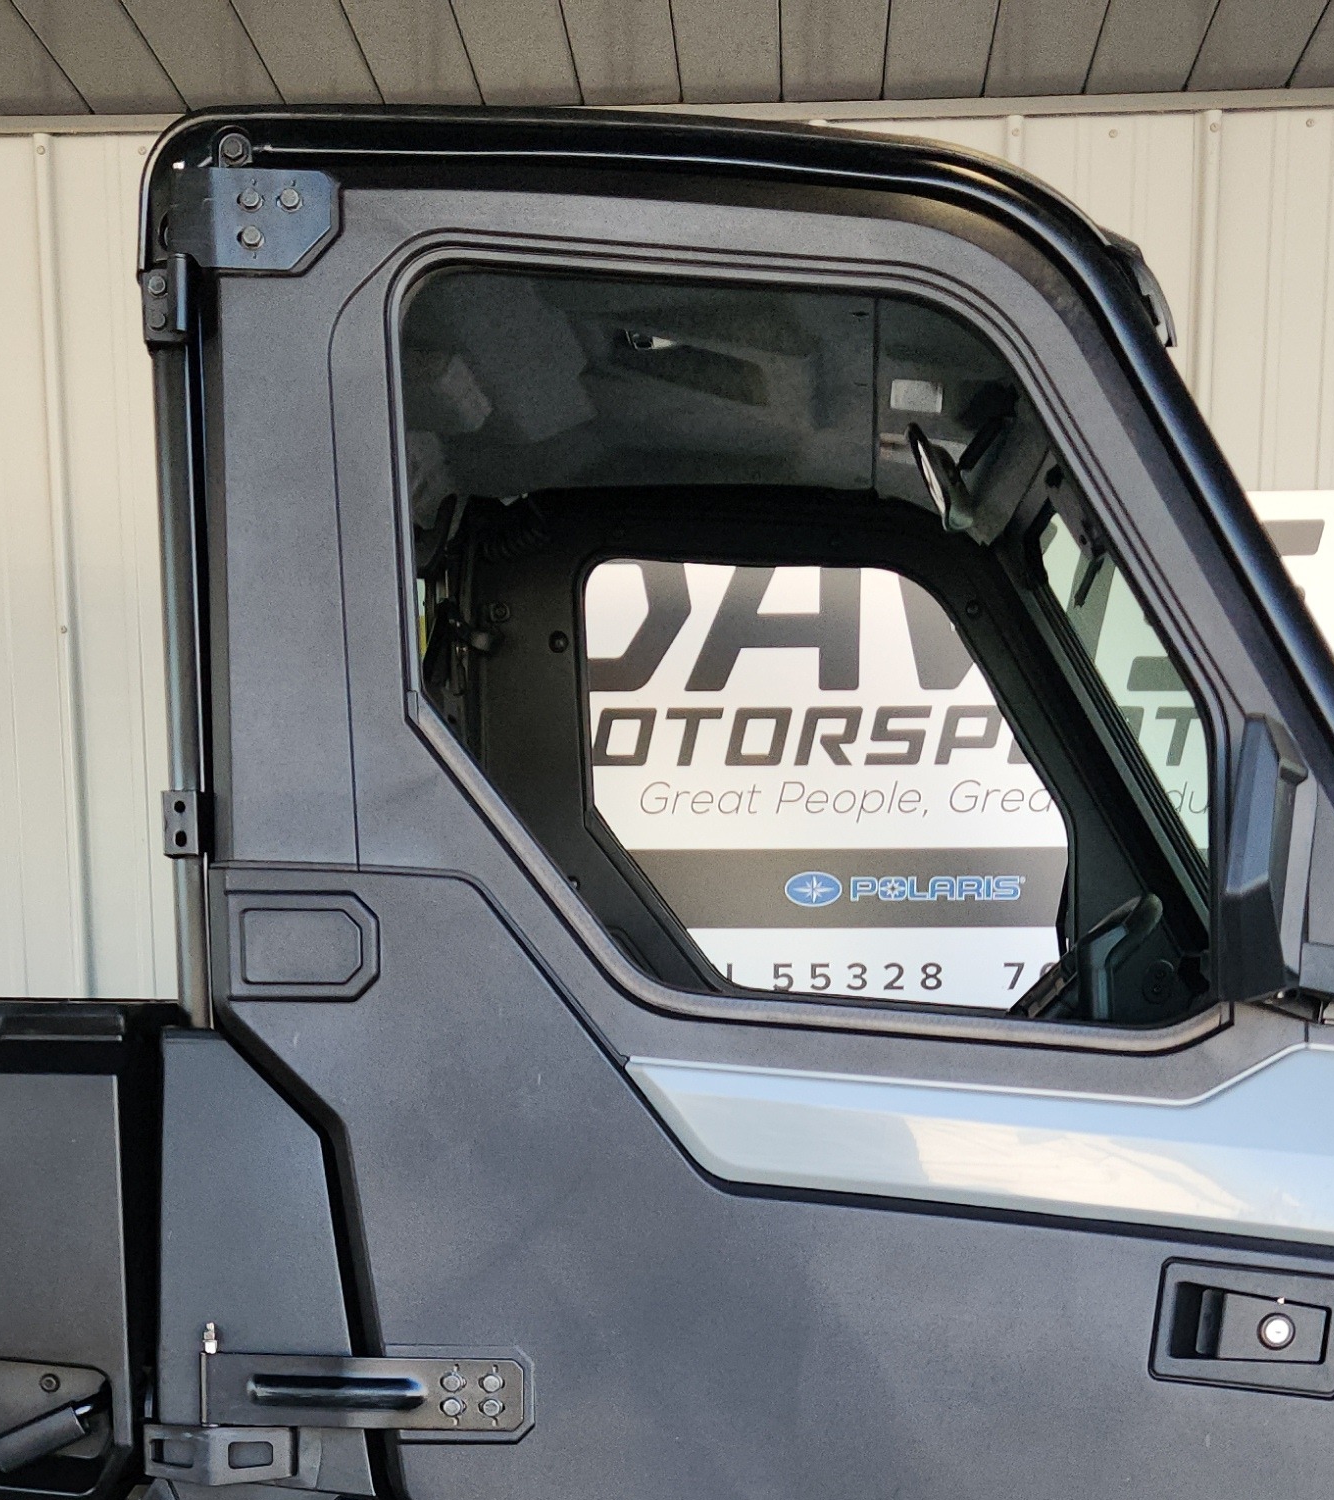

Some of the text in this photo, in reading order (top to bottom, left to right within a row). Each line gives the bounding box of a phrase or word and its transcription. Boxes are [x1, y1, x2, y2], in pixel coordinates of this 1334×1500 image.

[640, 780, 1054, 824] Great People, Grea
[849, 875, 1023, 902] POLARIS
[772, 963, 943, 991] 55328
